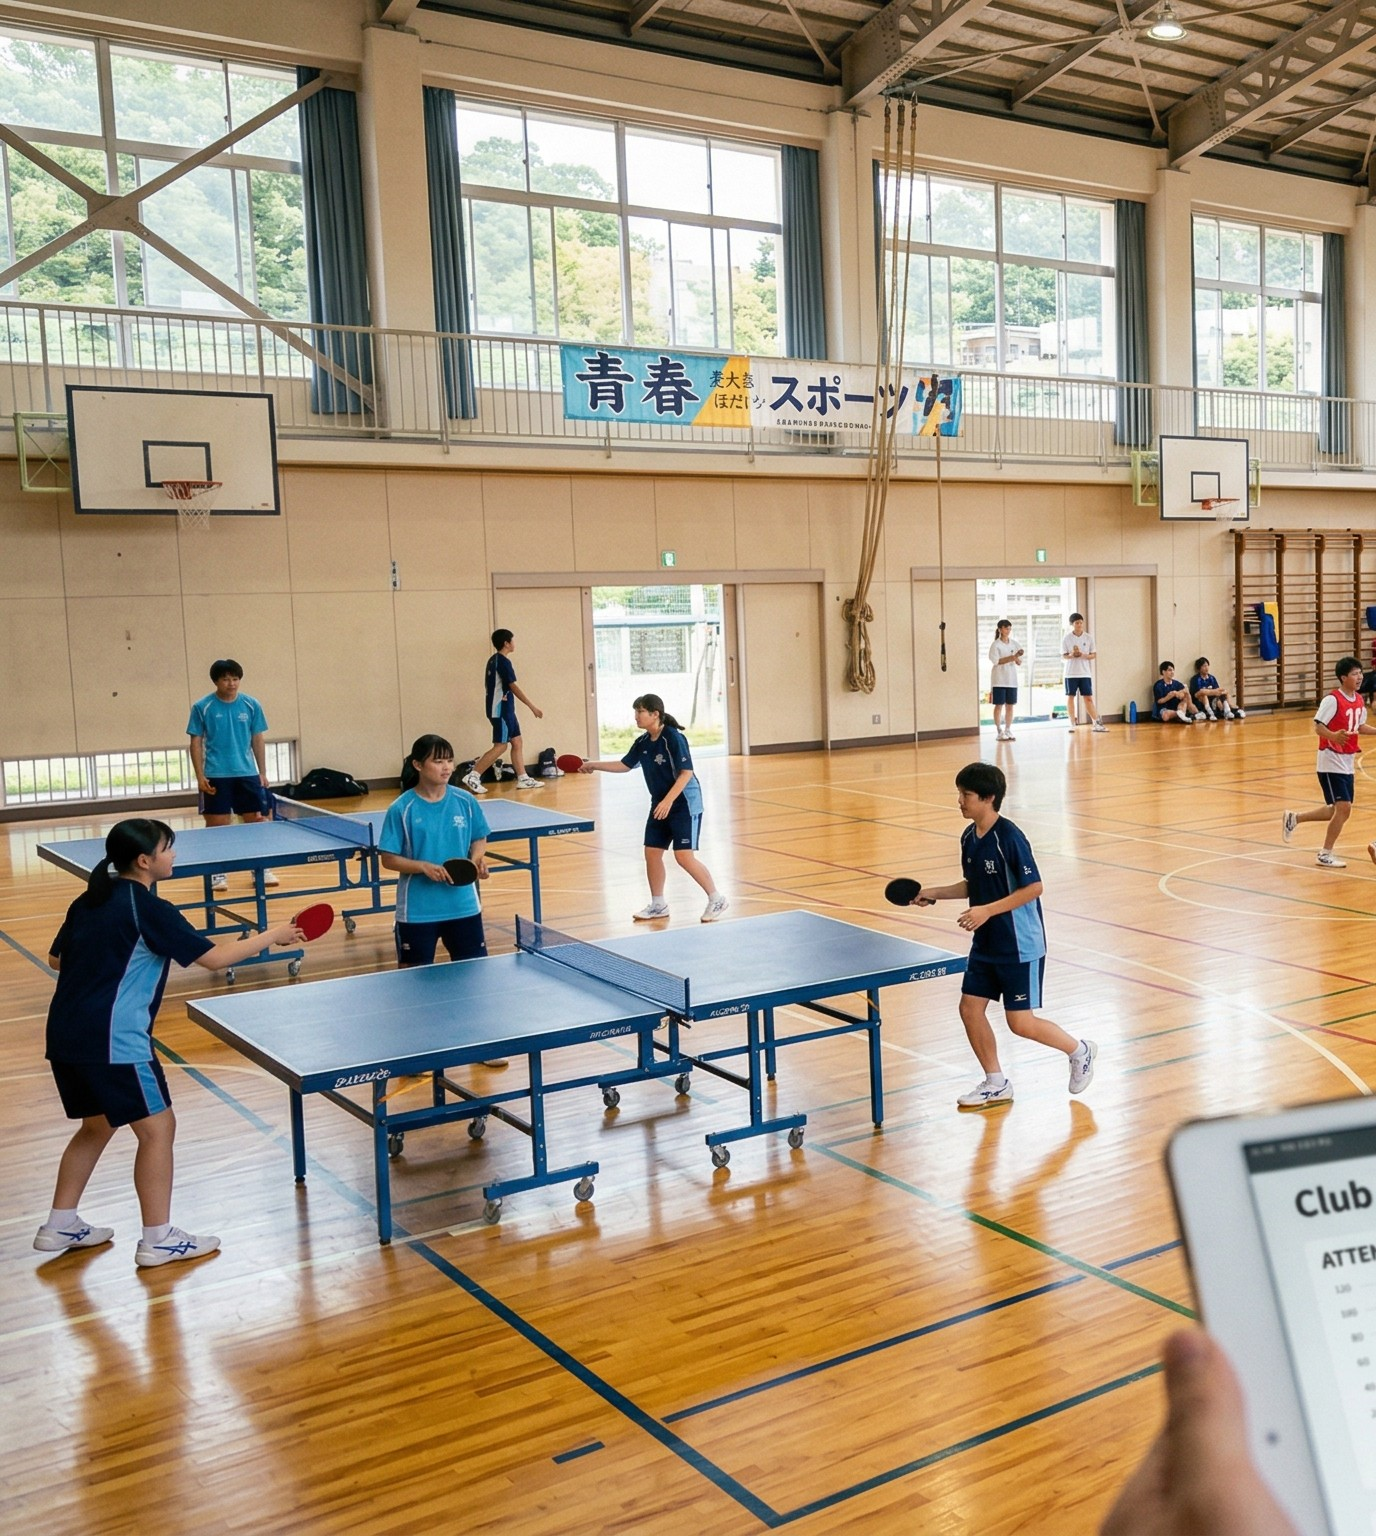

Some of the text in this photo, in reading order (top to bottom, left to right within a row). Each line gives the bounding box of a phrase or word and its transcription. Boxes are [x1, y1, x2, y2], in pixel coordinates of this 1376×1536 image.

[576, 351, 700, 416] 青春
[769, 375, 909, 419] スポーツ
[1295, 1180, 1373, 1218] Club
